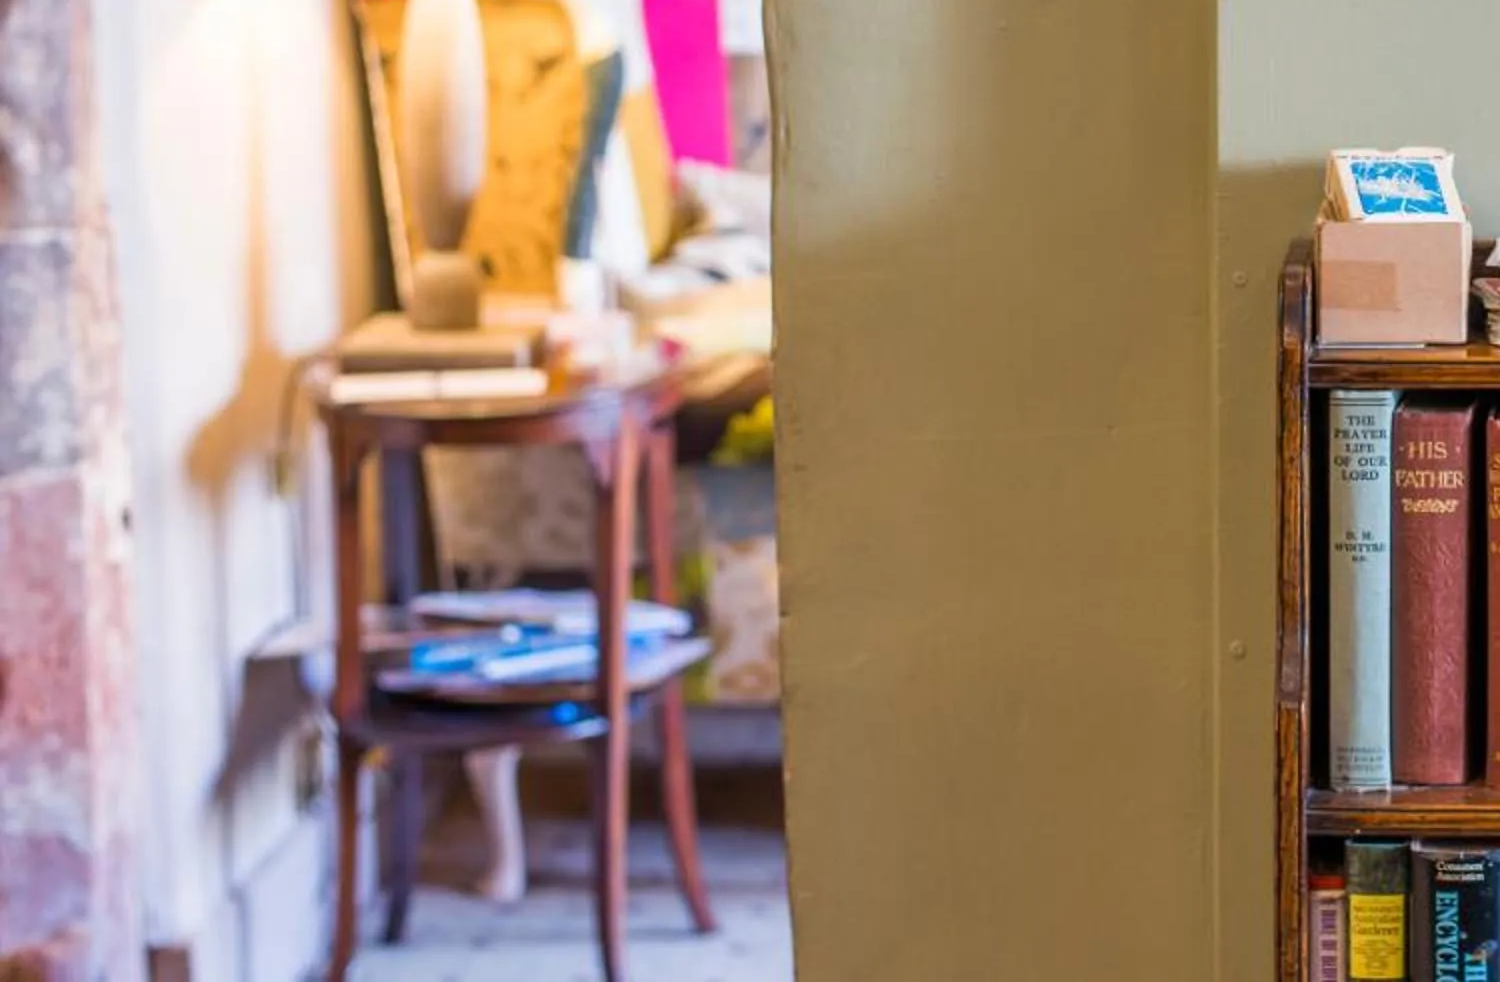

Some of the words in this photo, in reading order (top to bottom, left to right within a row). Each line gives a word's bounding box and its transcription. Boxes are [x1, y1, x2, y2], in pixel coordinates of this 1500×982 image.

[1345, 415, 1375, 426] THE
[1333, 428, 1387, 439] PRAYER
[1344, 442, 1375, 453] LIFE
[1408, 441, 1448, 459] HIS
[1333, 457, 1351, 468] OF
[1357, 456, 1387, 467] OUR
[1341, 470, 1379, 480] LORD
[1395, 470, 1465, 488] FATHER
